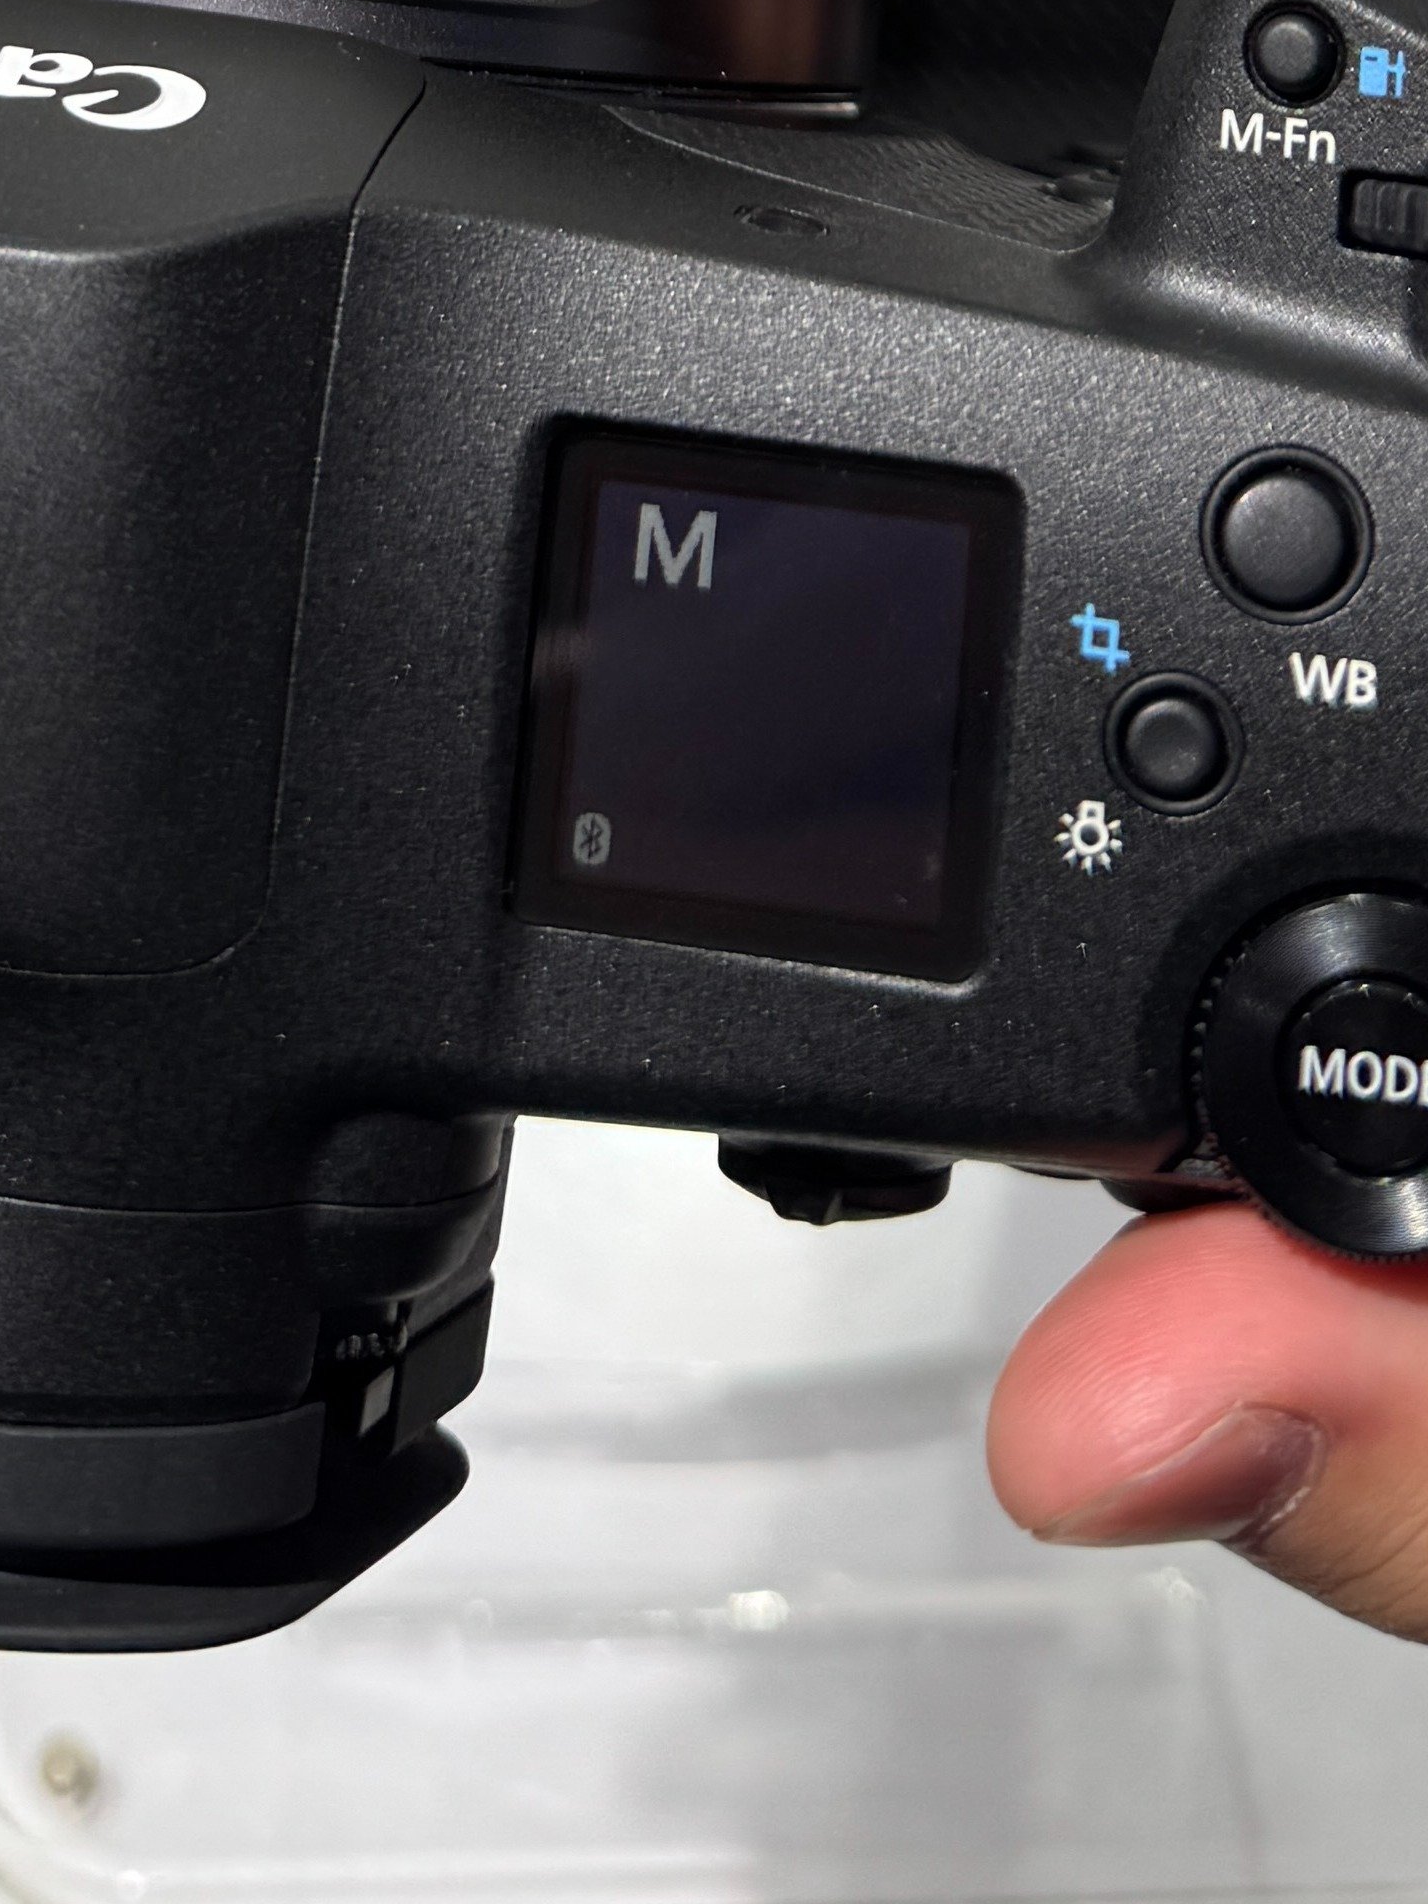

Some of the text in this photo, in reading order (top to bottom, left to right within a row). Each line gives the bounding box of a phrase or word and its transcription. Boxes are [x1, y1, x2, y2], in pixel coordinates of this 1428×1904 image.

[1218, 108, 1337, 164] M-Fn
[633, 502, 718, 590] M
[1288, 652, 1378, 710] WB
